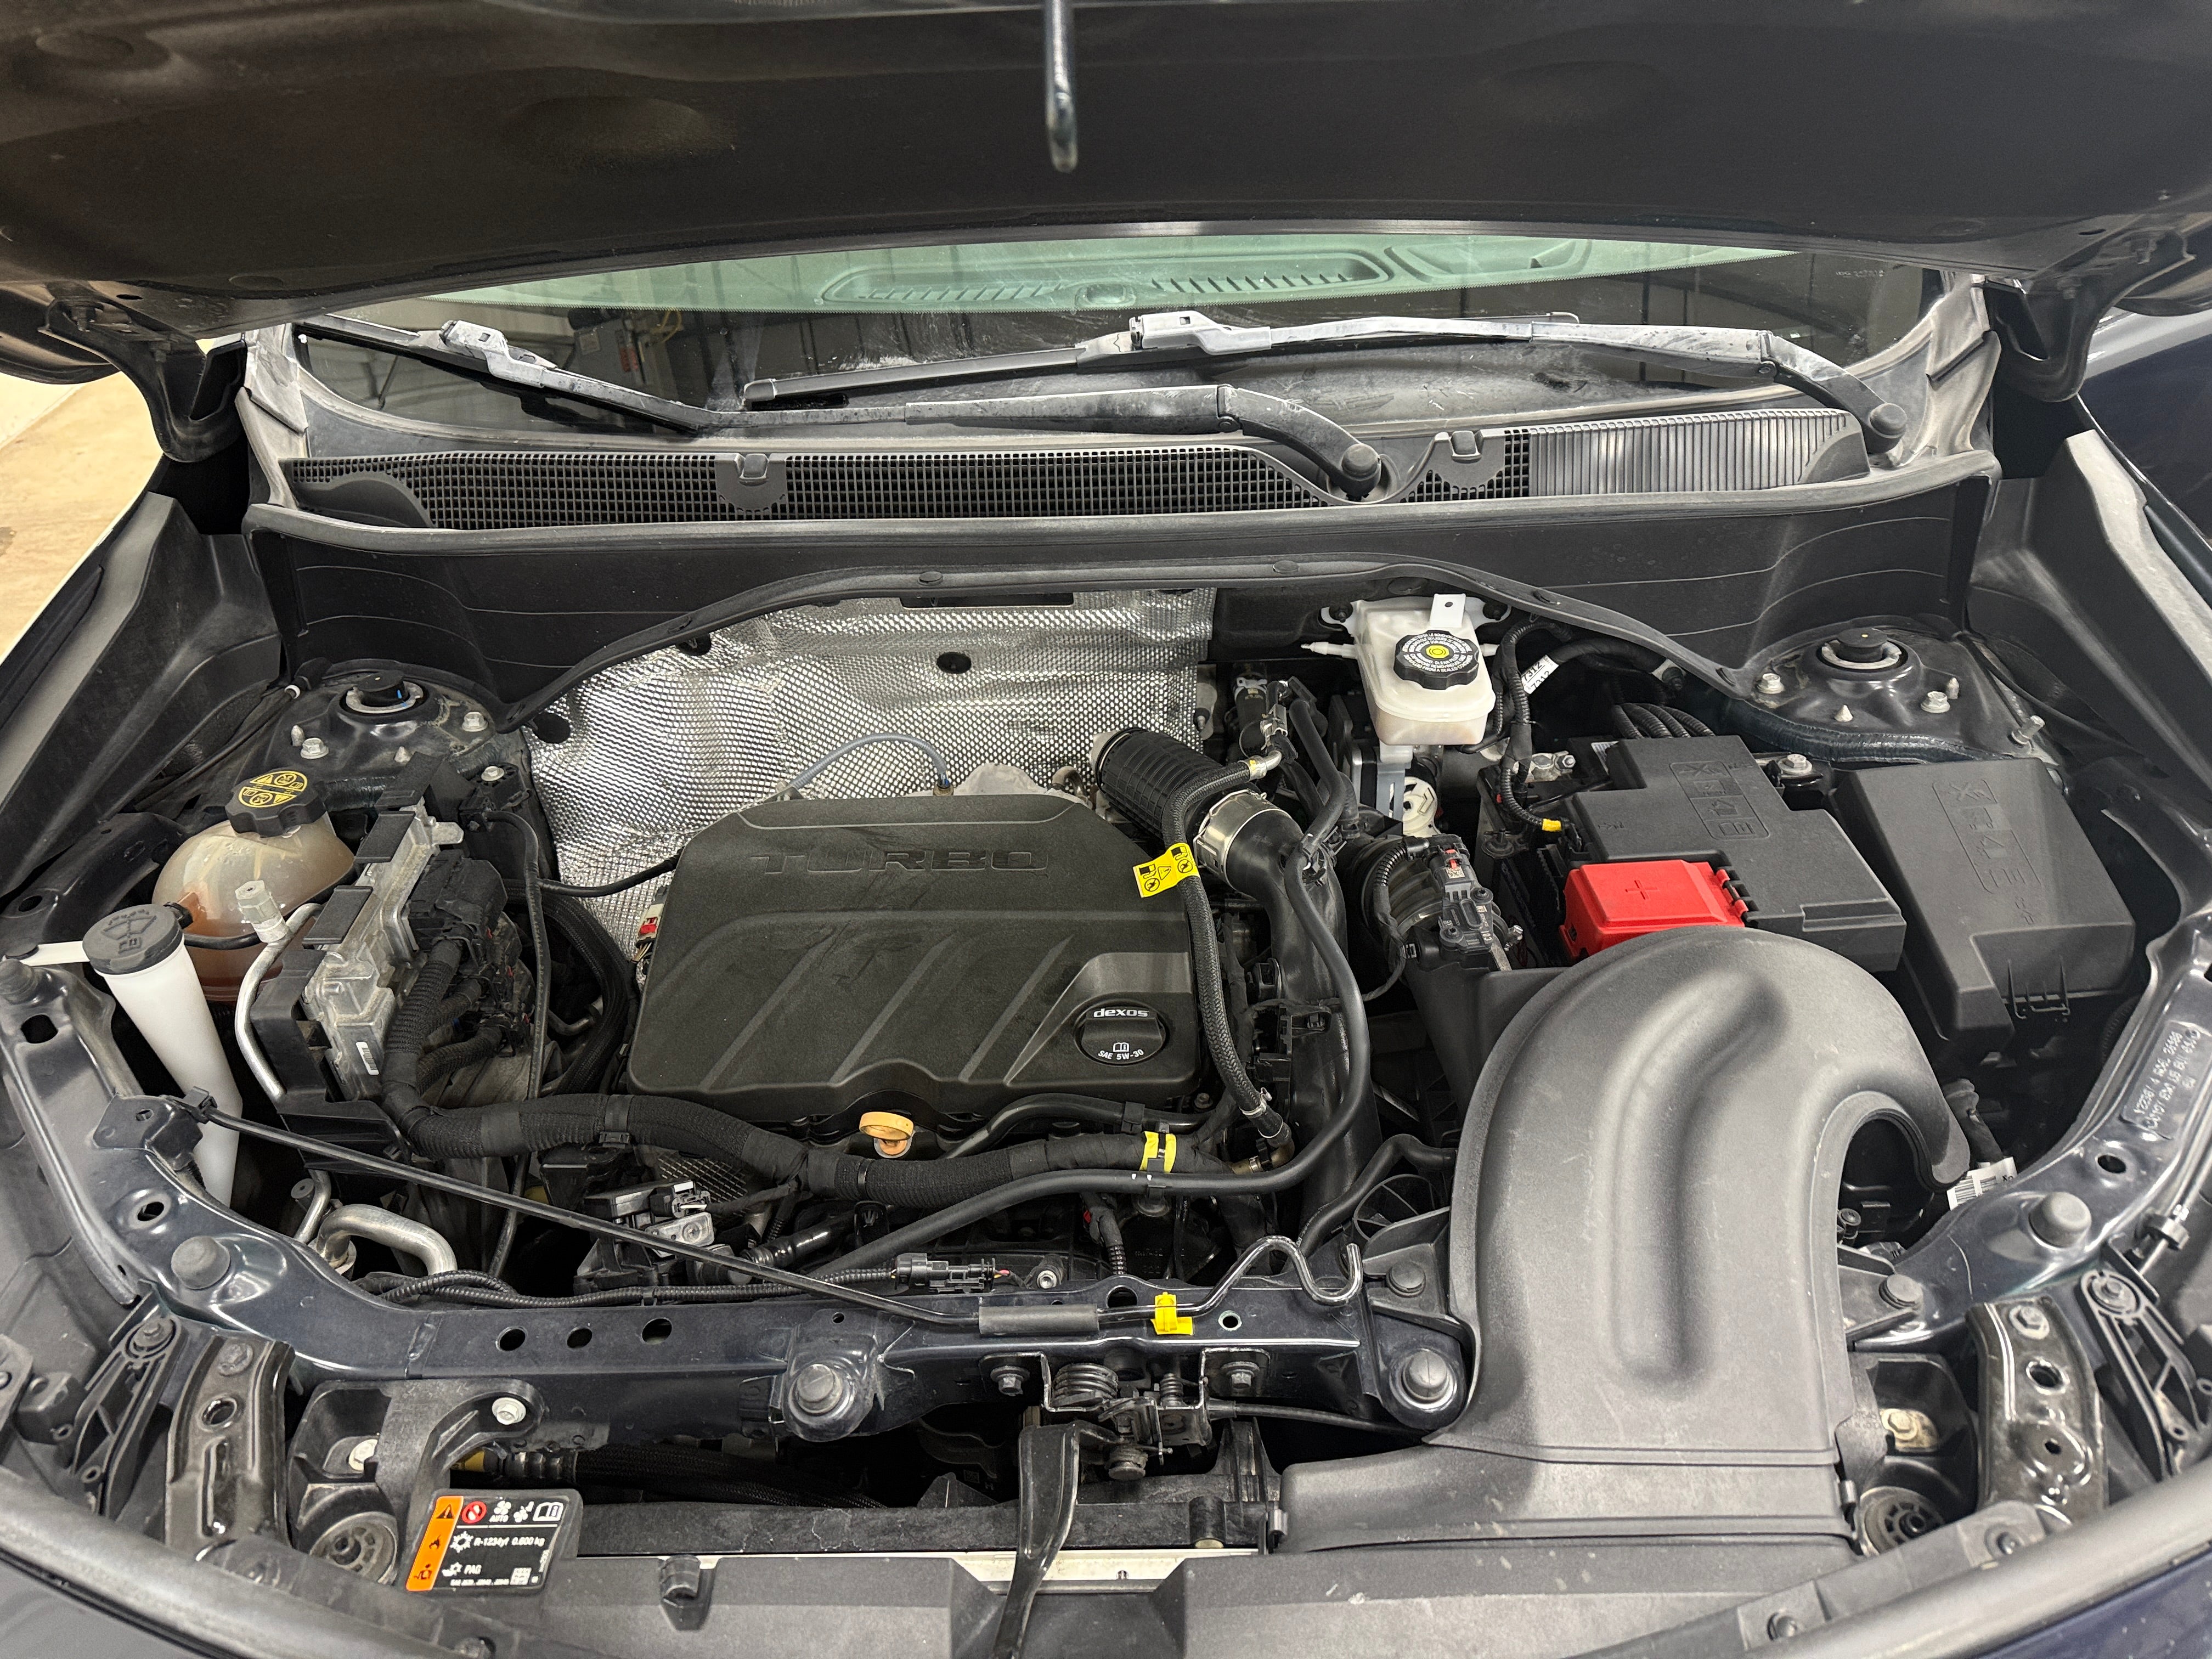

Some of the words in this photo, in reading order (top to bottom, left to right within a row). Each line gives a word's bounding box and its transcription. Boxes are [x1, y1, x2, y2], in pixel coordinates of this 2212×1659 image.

[1521, 662, 1542, 681] 7312
[749, 849, 1049, 874] TURBO
[1093, 1008, 1150, 1018] dexos
[1098, 1050, 1114, 1060] SAE
[1116, 1048, 1144, 1060] 5W-30
[473, 1537, 510, 1548] R-1234yf
[534, 1536, 545, 1547] kg
[464, 1564, 482, 1575] PAG
